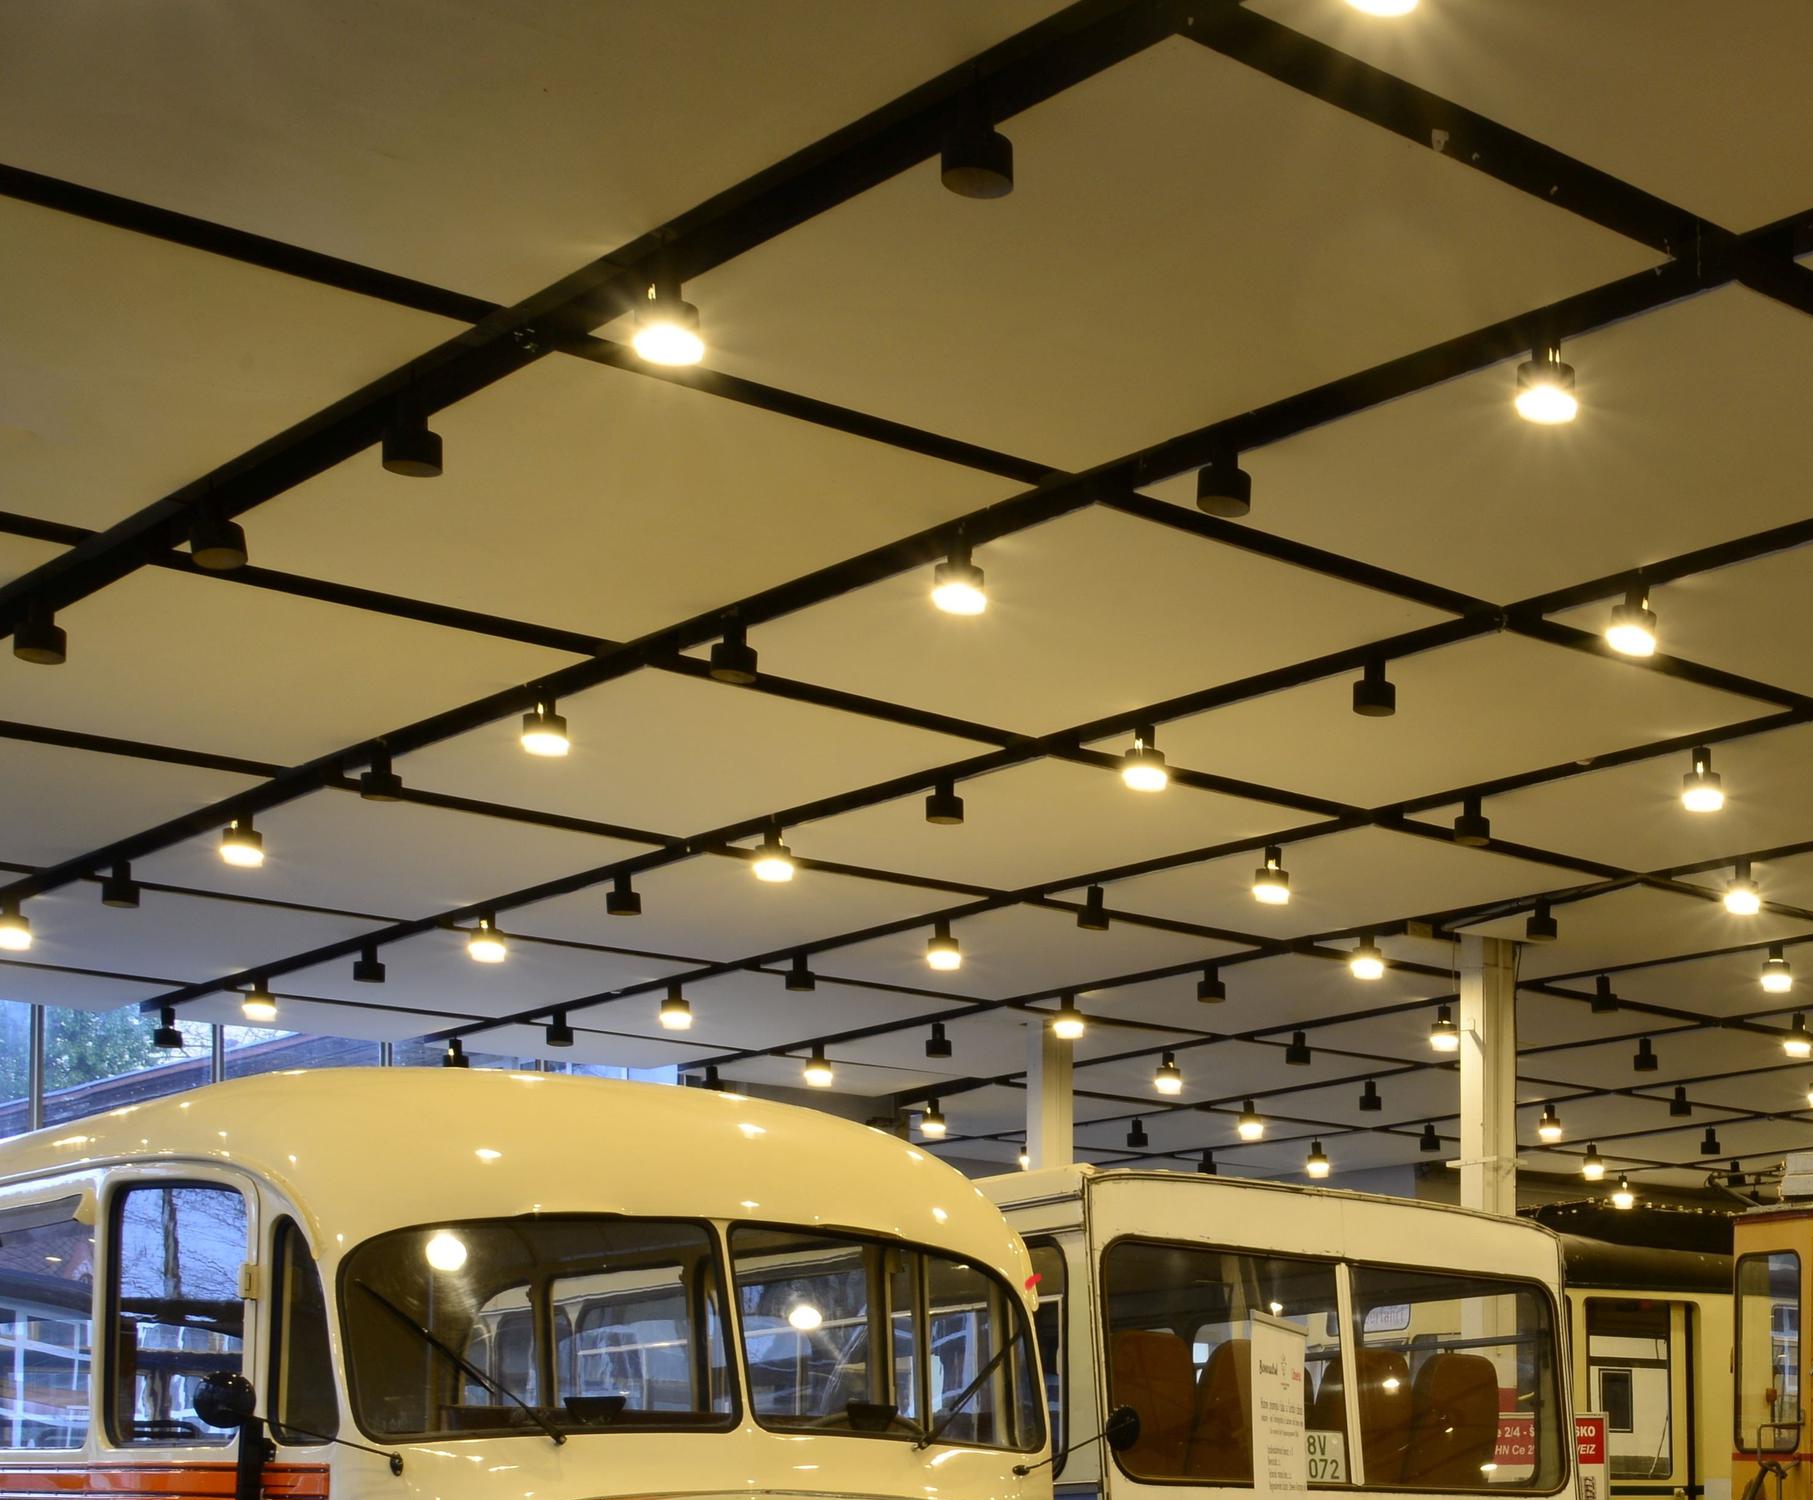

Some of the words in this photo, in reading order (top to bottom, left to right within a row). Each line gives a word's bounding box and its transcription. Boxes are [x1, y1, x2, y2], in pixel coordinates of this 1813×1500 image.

[1504, 1426, 1520, 1438] 2/4
[1307, 1435, 1326, 1455] 8V
[1512, 1444, 1525, 1455] Ce
[1308, 1459, 1340, 1480] 072
